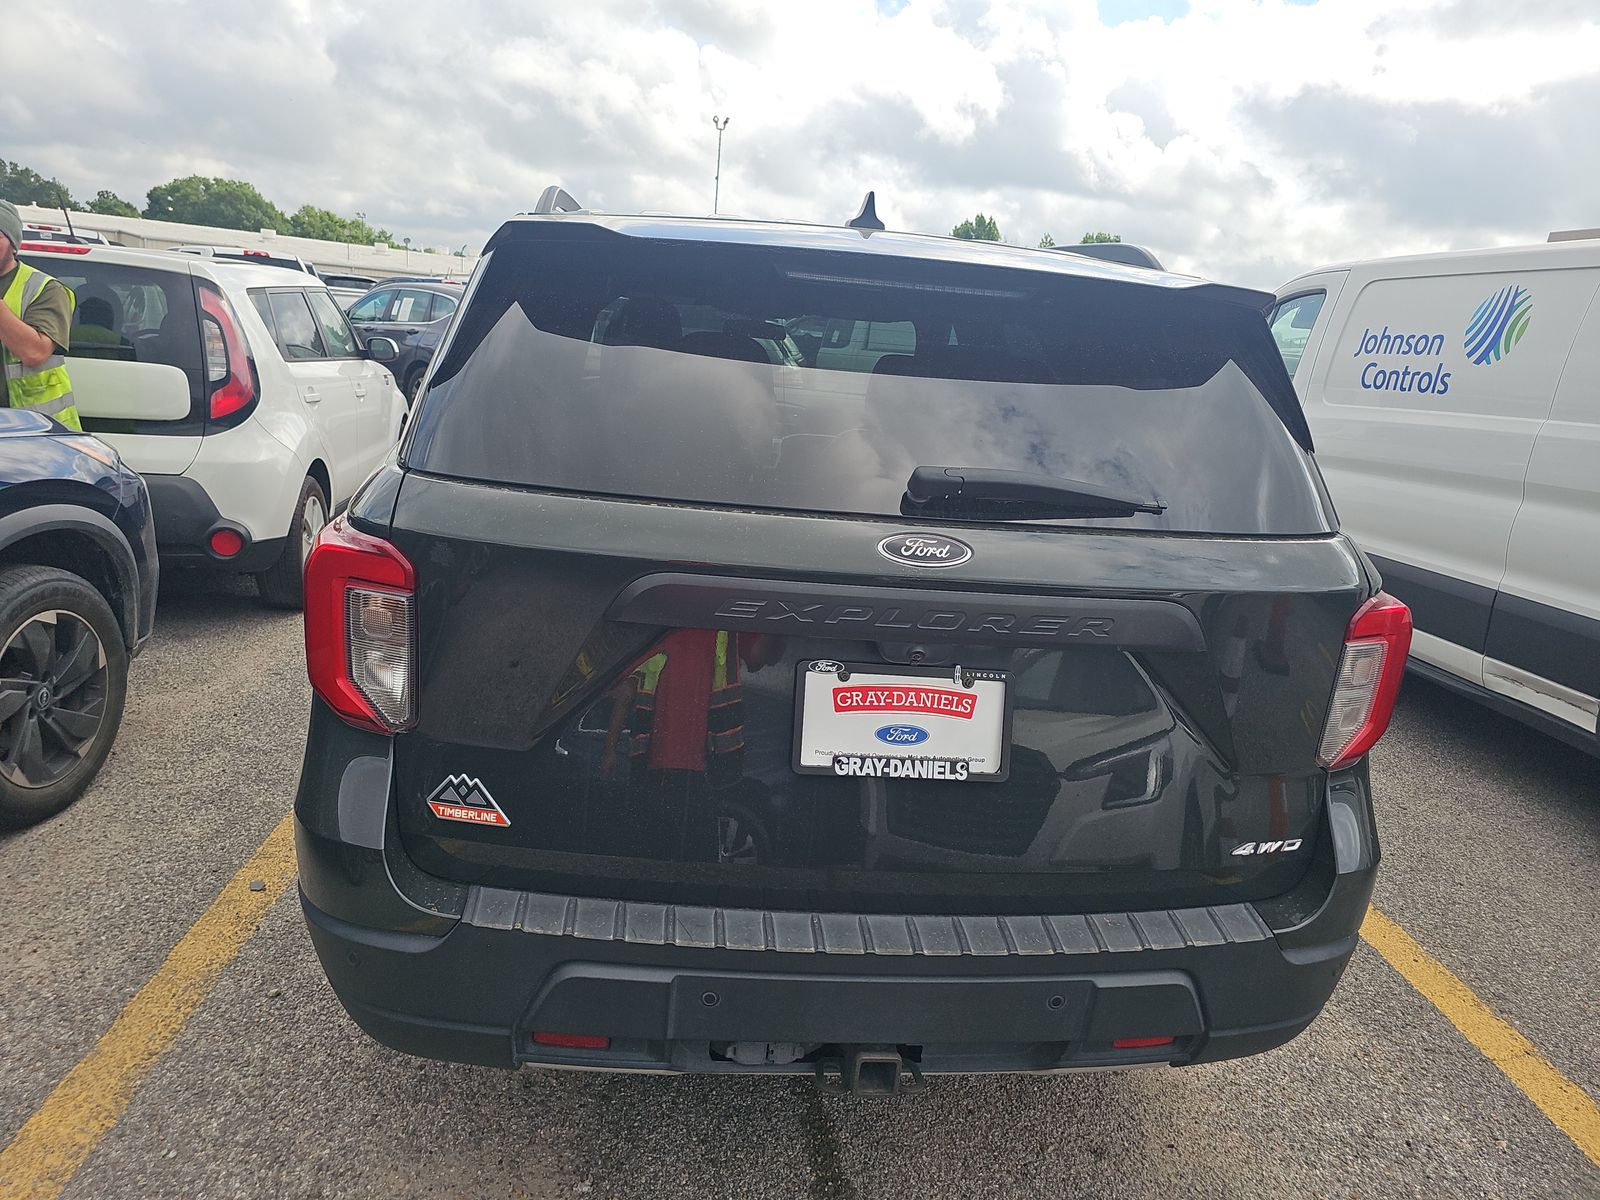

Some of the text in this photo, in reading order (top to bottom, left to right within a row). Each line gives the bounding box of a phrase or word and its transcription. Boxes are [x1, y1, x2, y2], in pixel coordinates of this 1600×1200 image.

[1353, 326, 1445, 358] Johnson
[1360, 362, 1452, 395] Controls
[900, 538, 951, 560] Ford
[714, 599, 1116, 637] EXPLORER
[815, 661, 838, 673] Ford
[966, 671, 1006, 679] LINCOLN
[836, 691, 972, 714] GRAY-DANIELS
[886, 727, 918, 742] Ford
[834, 757, 968, 780] GRAY-DANIELS
[438, 806, 497, 822] TIMBERLINE
[1230, 838, 1303, 855] 4WD
